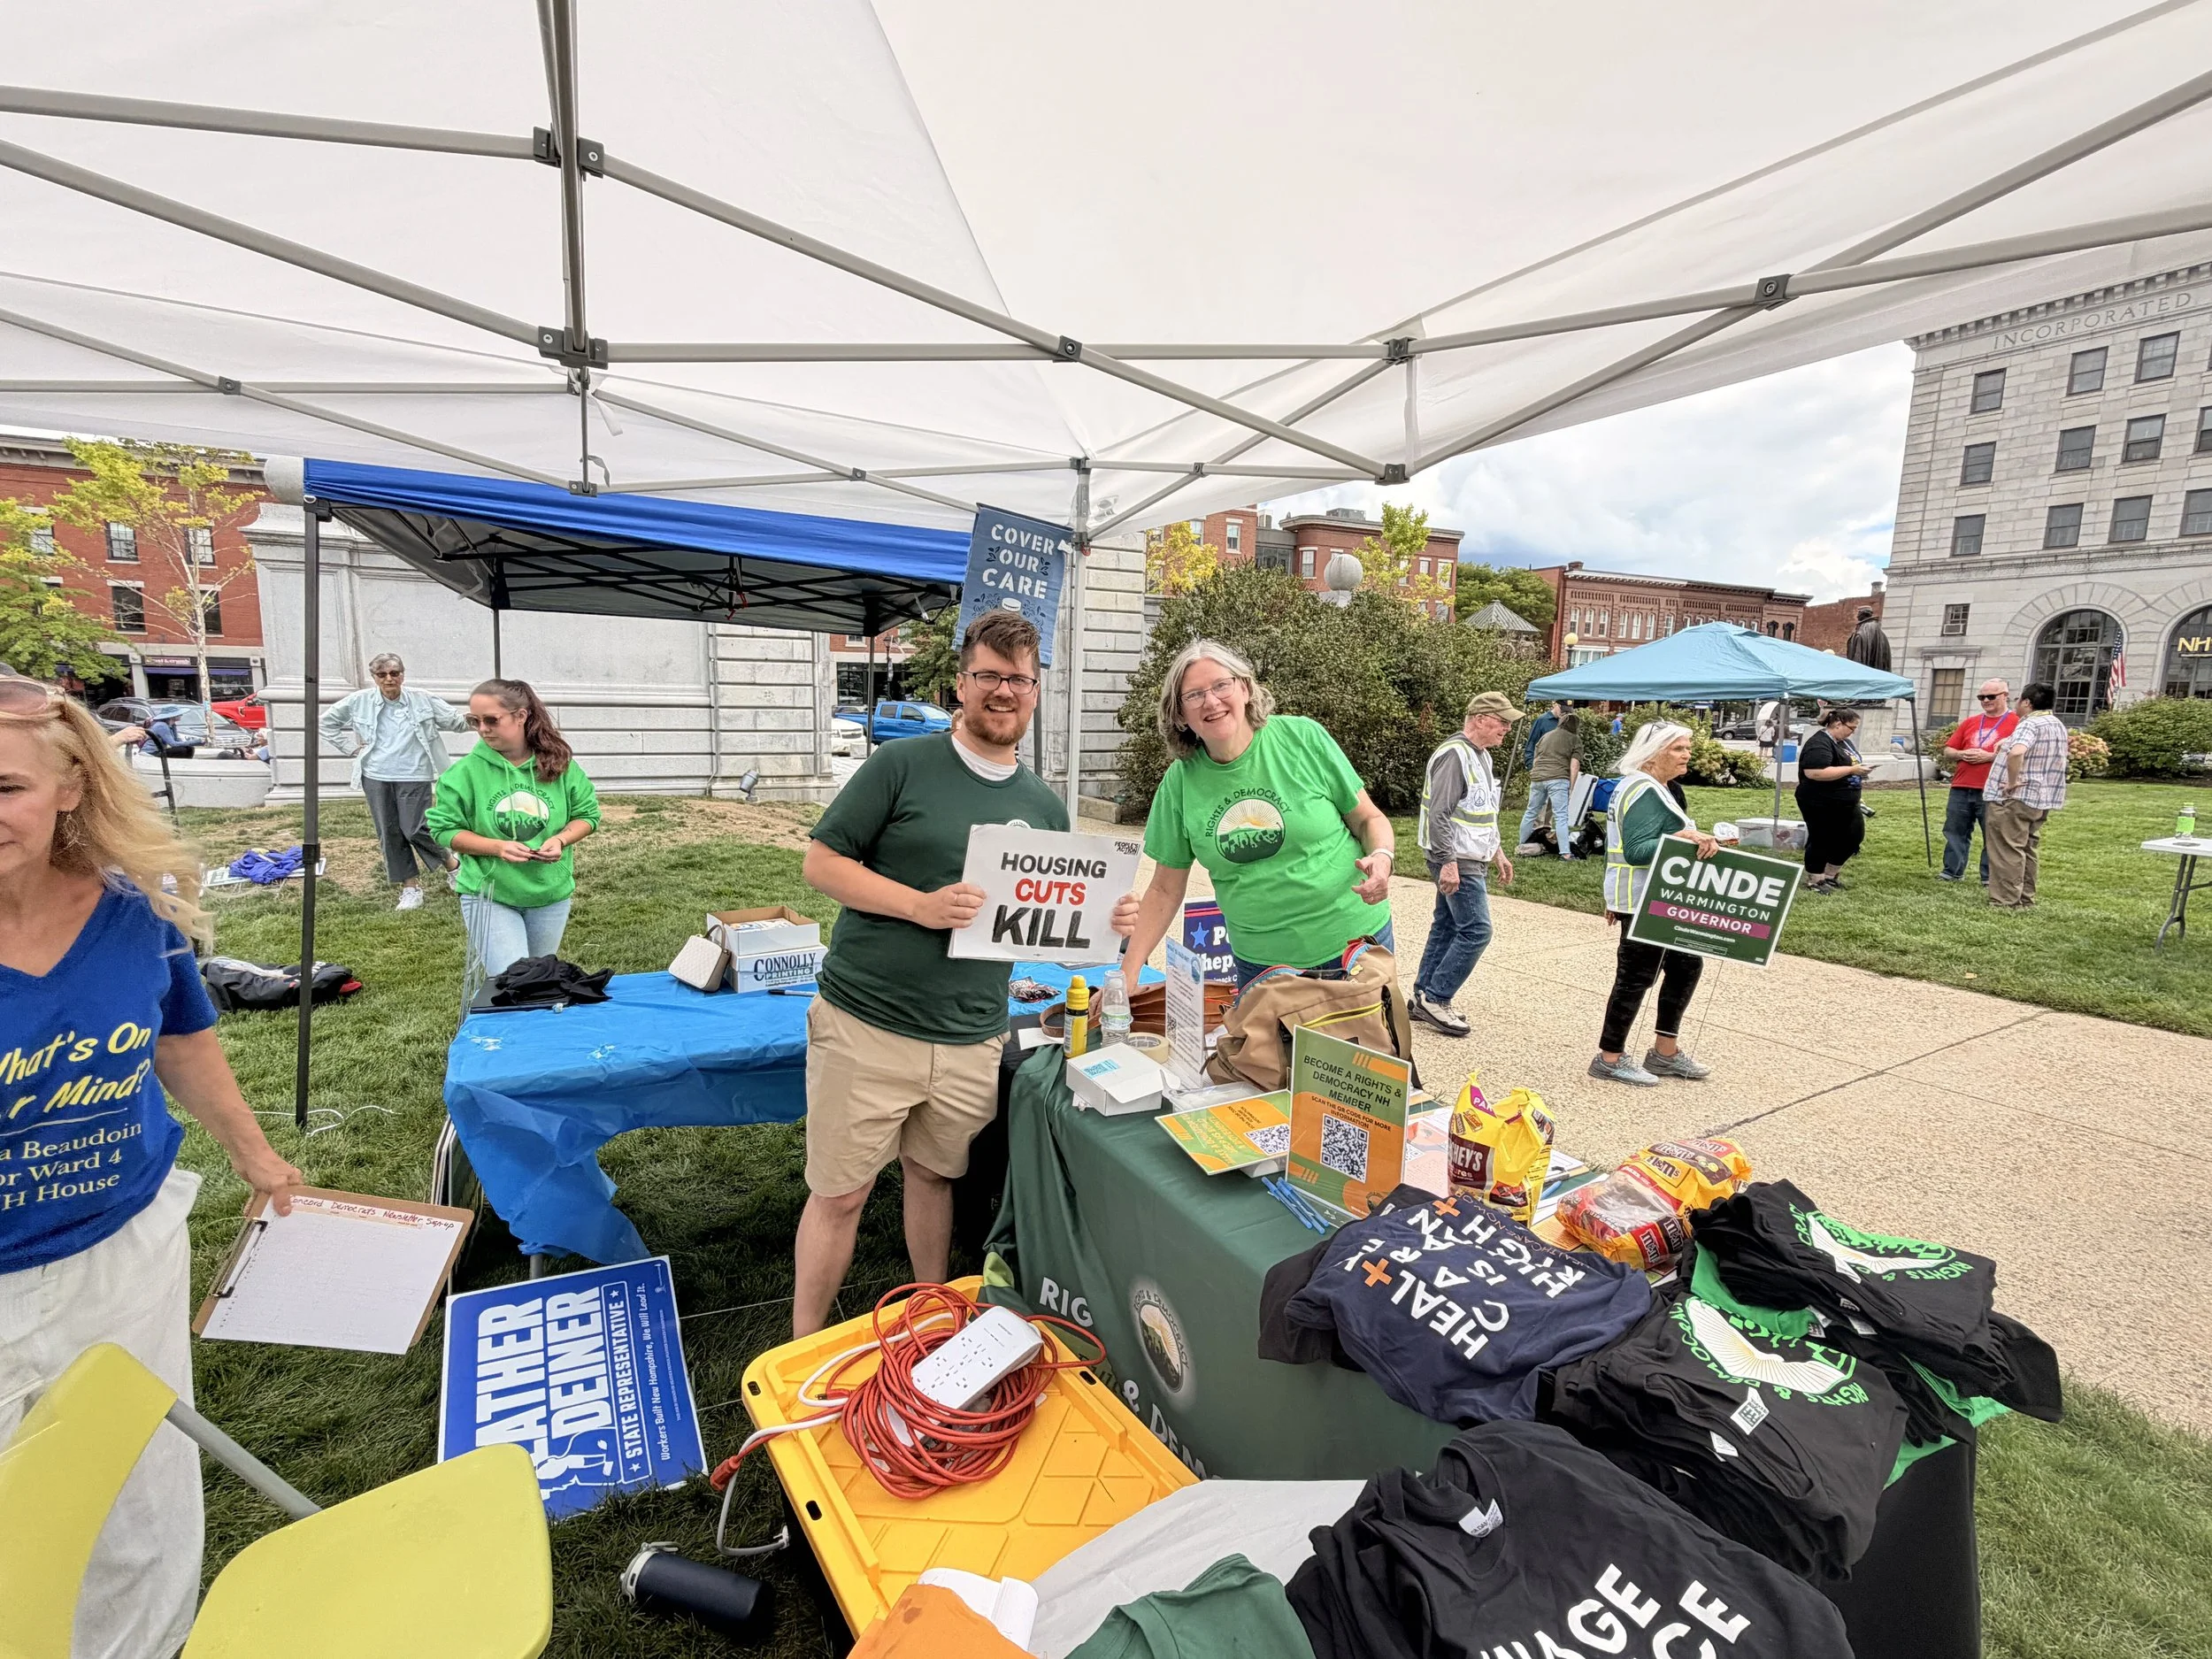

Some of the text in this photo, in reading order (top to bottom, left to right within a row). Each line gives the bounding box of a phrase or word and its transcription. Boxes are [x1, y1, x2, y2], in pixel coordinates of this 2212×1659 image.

[1993, 293, 2192, 349] INCORPORATED
[990, 523, 1055, 556] COVER
[999, 549, 1040, 573] OUR
[982, 567, 1048, 600] CARE
[487, 790, 507, 811] RIGHTS
[1205, 787, 1292, 837] RIGHTS & DEMOCRACY
[1001, 851, 1108, 879] HOUSING
[1015, 878, 1087, 906] CUTS
[1661, 856, 1786, 908] CINDE
[1660, 887, 1770, 921] WARMINGTON
[1667, 906, 1753, 934] GOVERNOR
[991, 904, 1091, 949] KILL
[754, 952, 816, 981] CONNOLLY
[766, 968, 811, 980] PRINTING
[1197, 952, 1237, 972] hep
[107, 1021, 151, 1055] On
[43, 1058, 150, 1113] Mind?
[1304, 1055, 1402, 1098] BECOME A RIGHTS &
[1312, 1071, 1391, 1108] DEMOCRACY NH
[1311, 1095, 1392, 1133] SCAN THE QR CODE FOR MORE
[1328, 1089, 1371, 1113] MEMBER
[1330, 1110, 1370, 1130] INFORMATION
[21, 1122, 142, 1159] Beaudoin
[1449, 1141, 1483, 1172] HEY'S
[28, 1152, 101, 1182] Ward
[108, 1148, 122, 1165] 4
[2, 1174, 120, 1211] H House
[330, 1202, 376, 1216] Democrats
[382, 1210, 423, 1223] Newsletter
[426, 1217, 455, 1231] Sign-up
[1905, 1261, 1976, 1281] RIGHTS
[635, 1294, 648, 1310] Lead
[636, 1283, 646, 1294] It.
[1039, 1277, 1094, 1327] RIG
[638, 1311, 649, 1328] Will
[642, 1328, 651, 1341] We
[475, 1297, 549, 1460] ATHER
[546, 1286, 618, 1440] DEINER
[643, 1341, 658, 1386] Hampshire,
[609, 1301, 643, 1459] STATE REPRESENTATIVE
[1773, 1385, 1793, 1401] &
[651, 1405, 664, 1425] Built
[657, 1426, 670, 1460] Workers
[1652, 1579, 1752, 1659] CE
